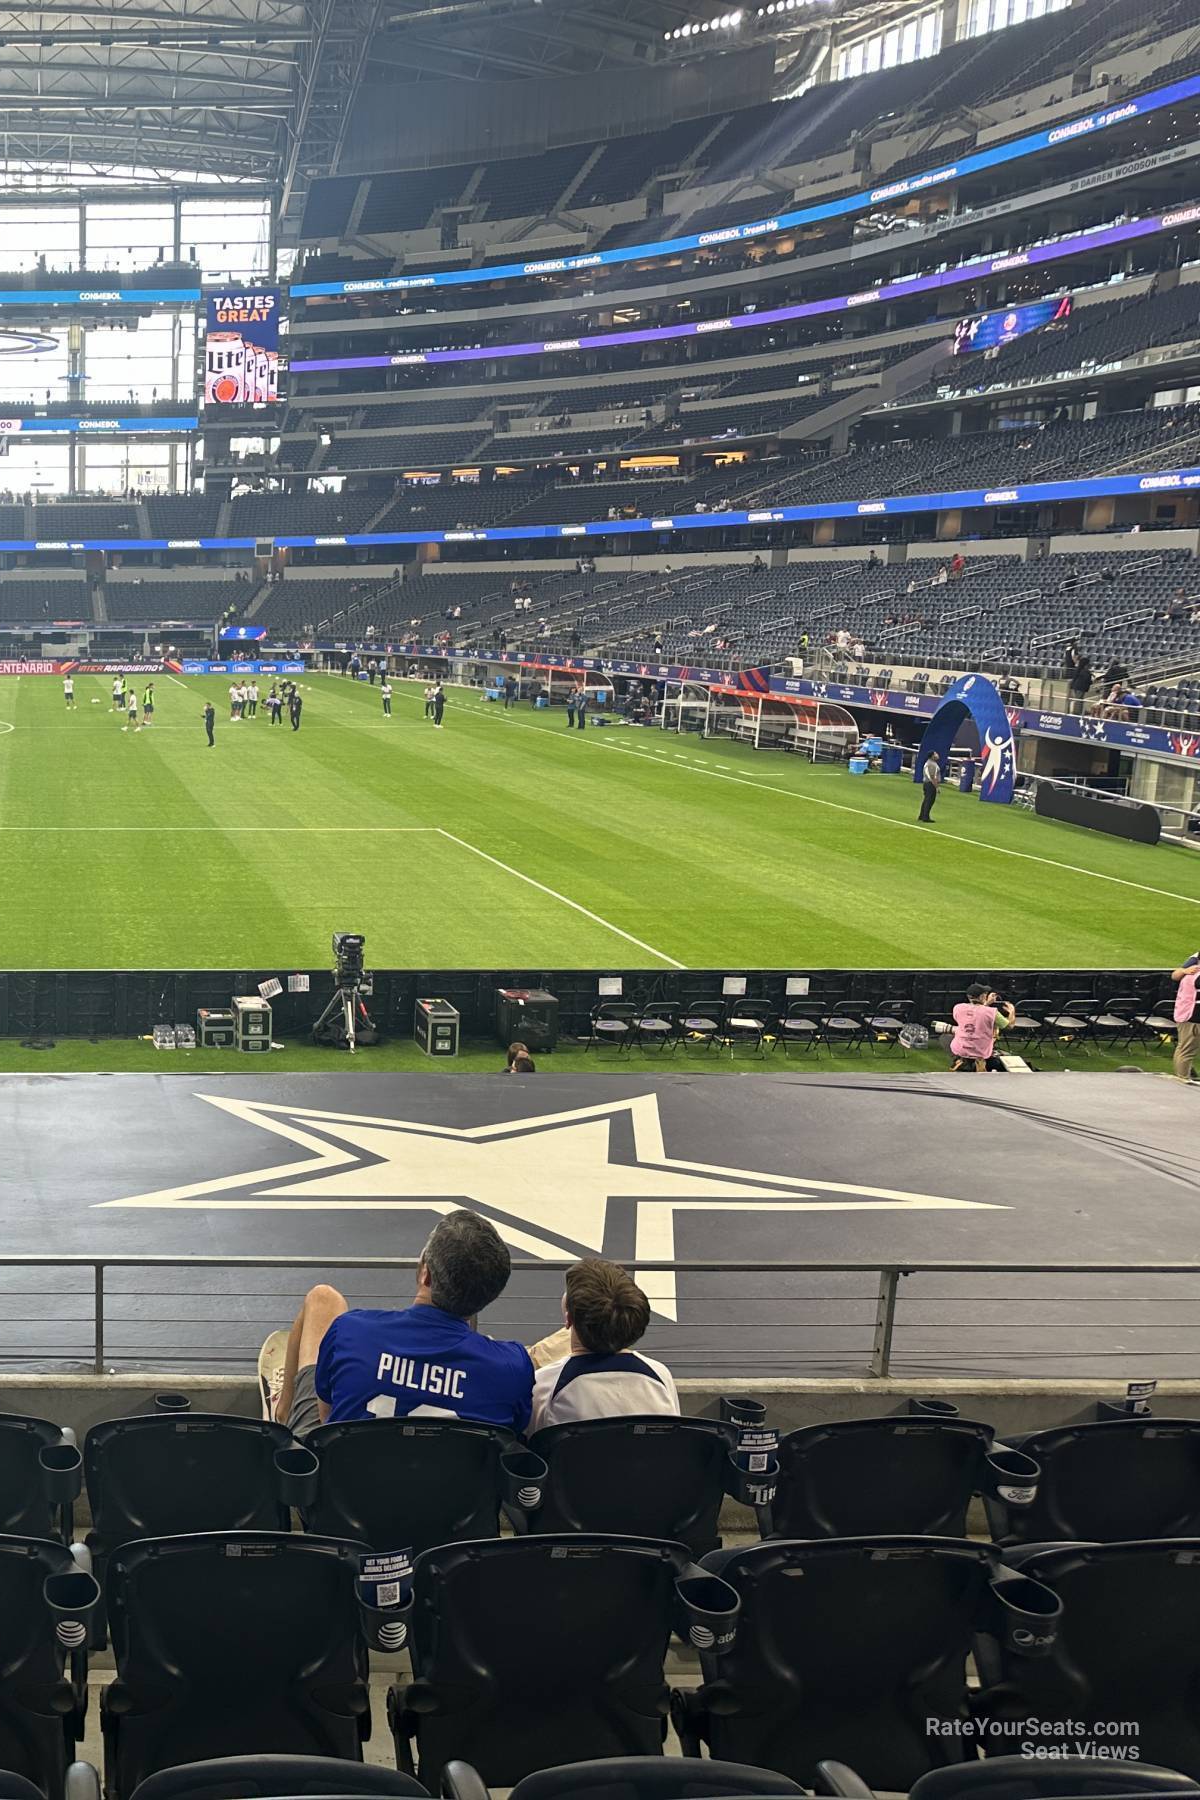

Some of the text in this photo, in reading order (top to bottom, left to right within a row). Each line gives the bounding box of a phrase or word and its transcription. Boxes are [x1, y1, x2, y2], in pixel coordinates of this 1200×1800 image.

[1049, 115, 1094, 142] CONMEBOL
[1081, 172, 1113, 187] DARREN
[1115, 158, 1157, 177] WOODSON
[524, 261, 566, 272] CONMEBOL
[344, 282, 385, 291] CONMEBOL
[80, 292, 122, 301] CONMEBOL
[213, 296, 275, 310] TASTES
[216, 309, 269, 323] GREAT
[208, 351, 243, 374] Lite
[79, 420, 121, 429] CONMEBOL
[78, 664, 164, 673] INTER RAPIDISIMO
[377, 1352, 468, 1399] PULISIC
[749, 1486, 776, 1505] Lit
